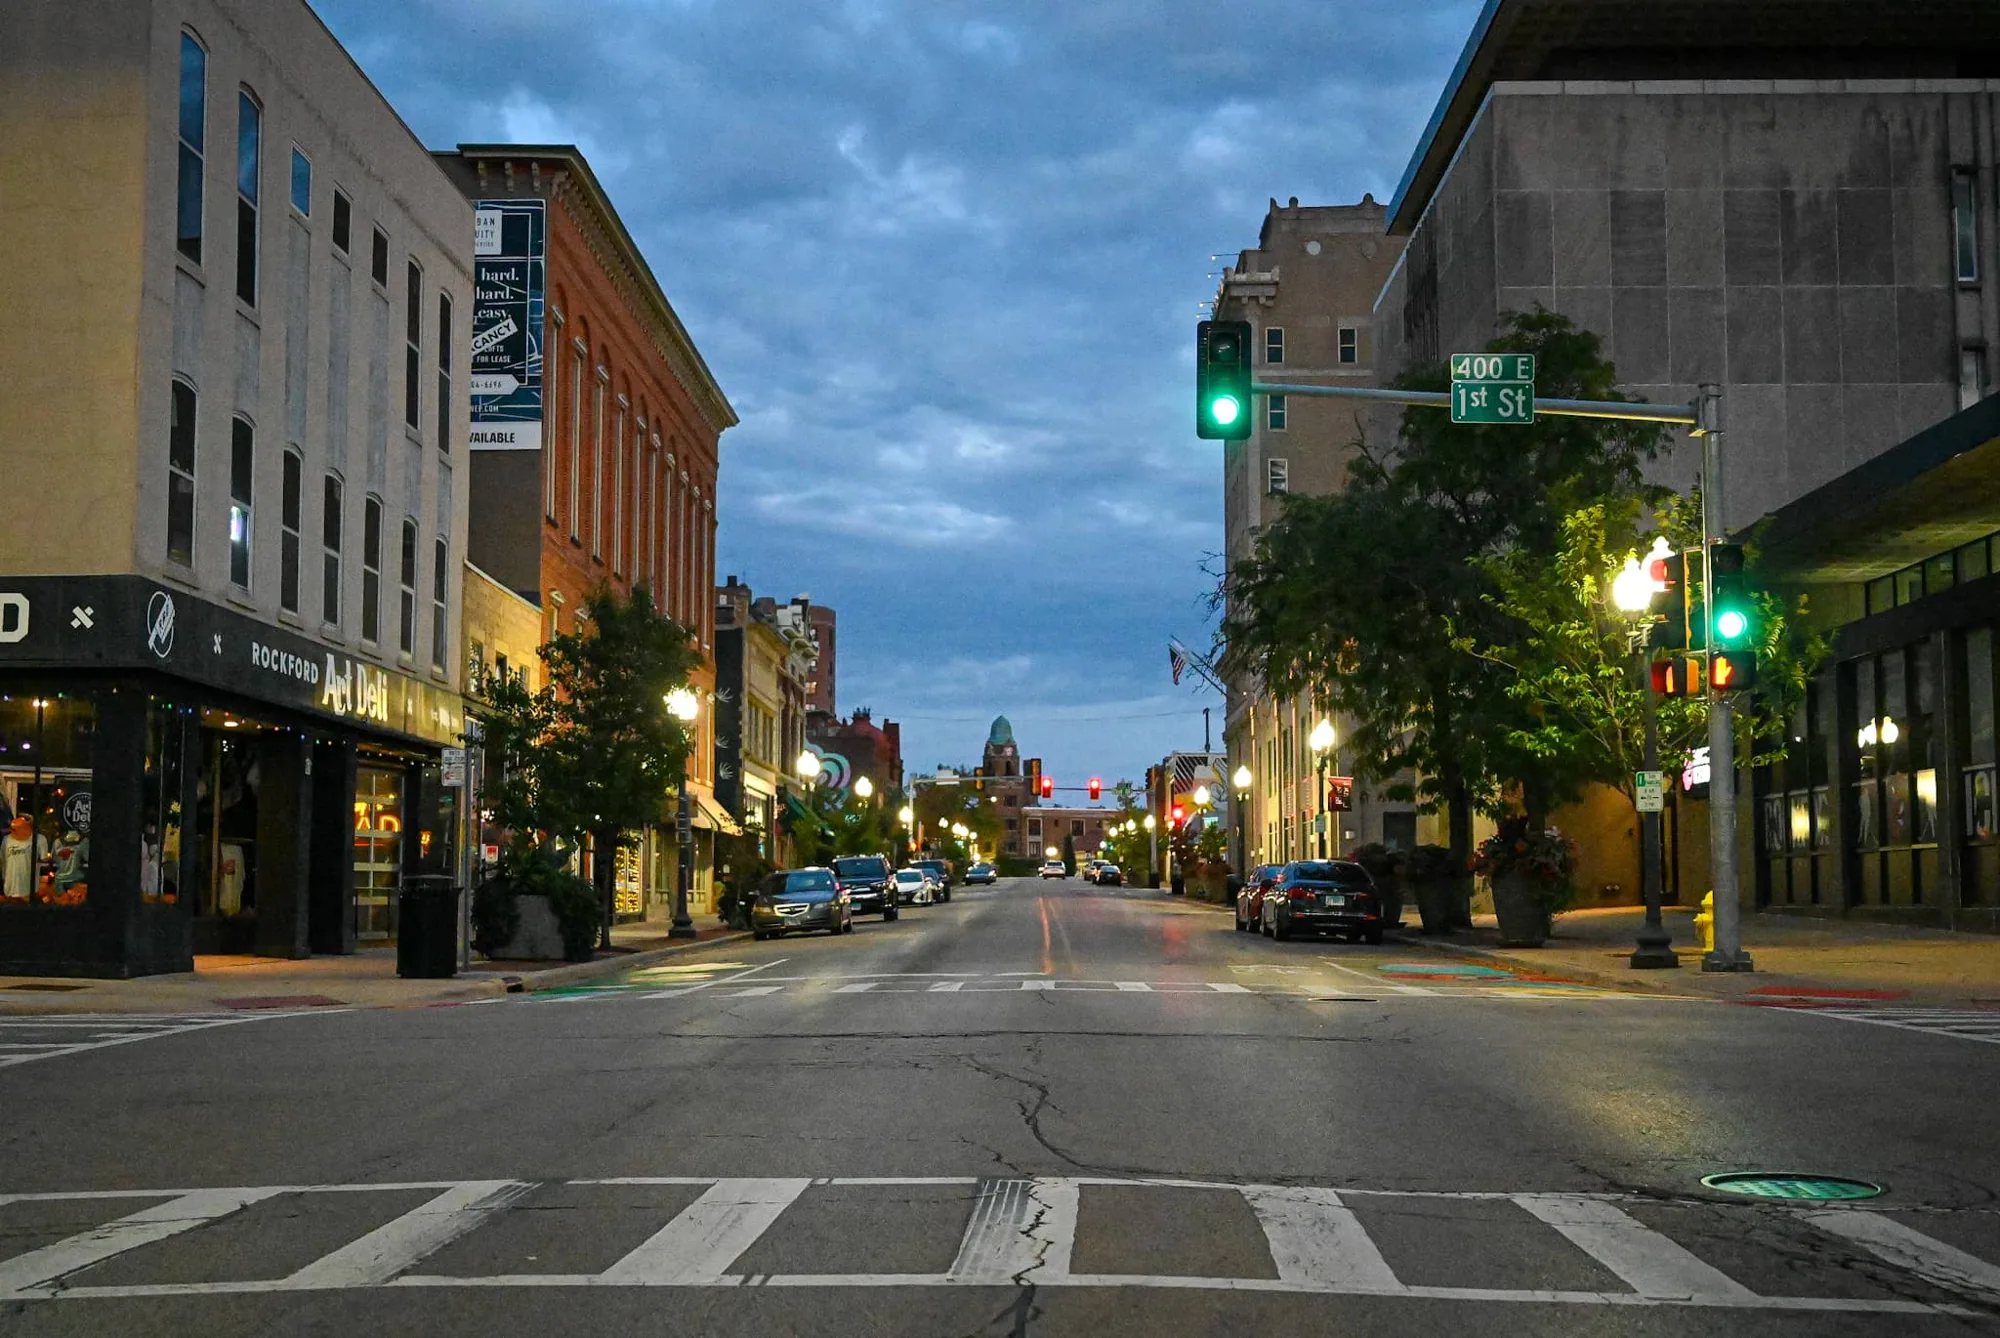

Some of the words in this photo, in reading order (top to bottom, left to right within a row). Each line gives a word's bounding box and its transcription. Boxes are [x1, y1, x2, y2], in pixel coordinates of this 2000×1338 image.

[481, 267, 519, 281] hard.
[476, 286, 514, 300] hard.
[478, 308, 512, 321] easy.
[471, 321, 512, 352] CANCY
[491, 354, 511, 363] LEASE
[1457, 357, 1503, 379] 400
[1517, 358, 1529, 379] E
[1458, 386, 1488, 417] 1st
[1498, 388, 1526, 418] St
[252, 641, 319, 685] ROCKFORD
[321, 652, 352, 716] Art
[356, 663, 388, 722] Deli
